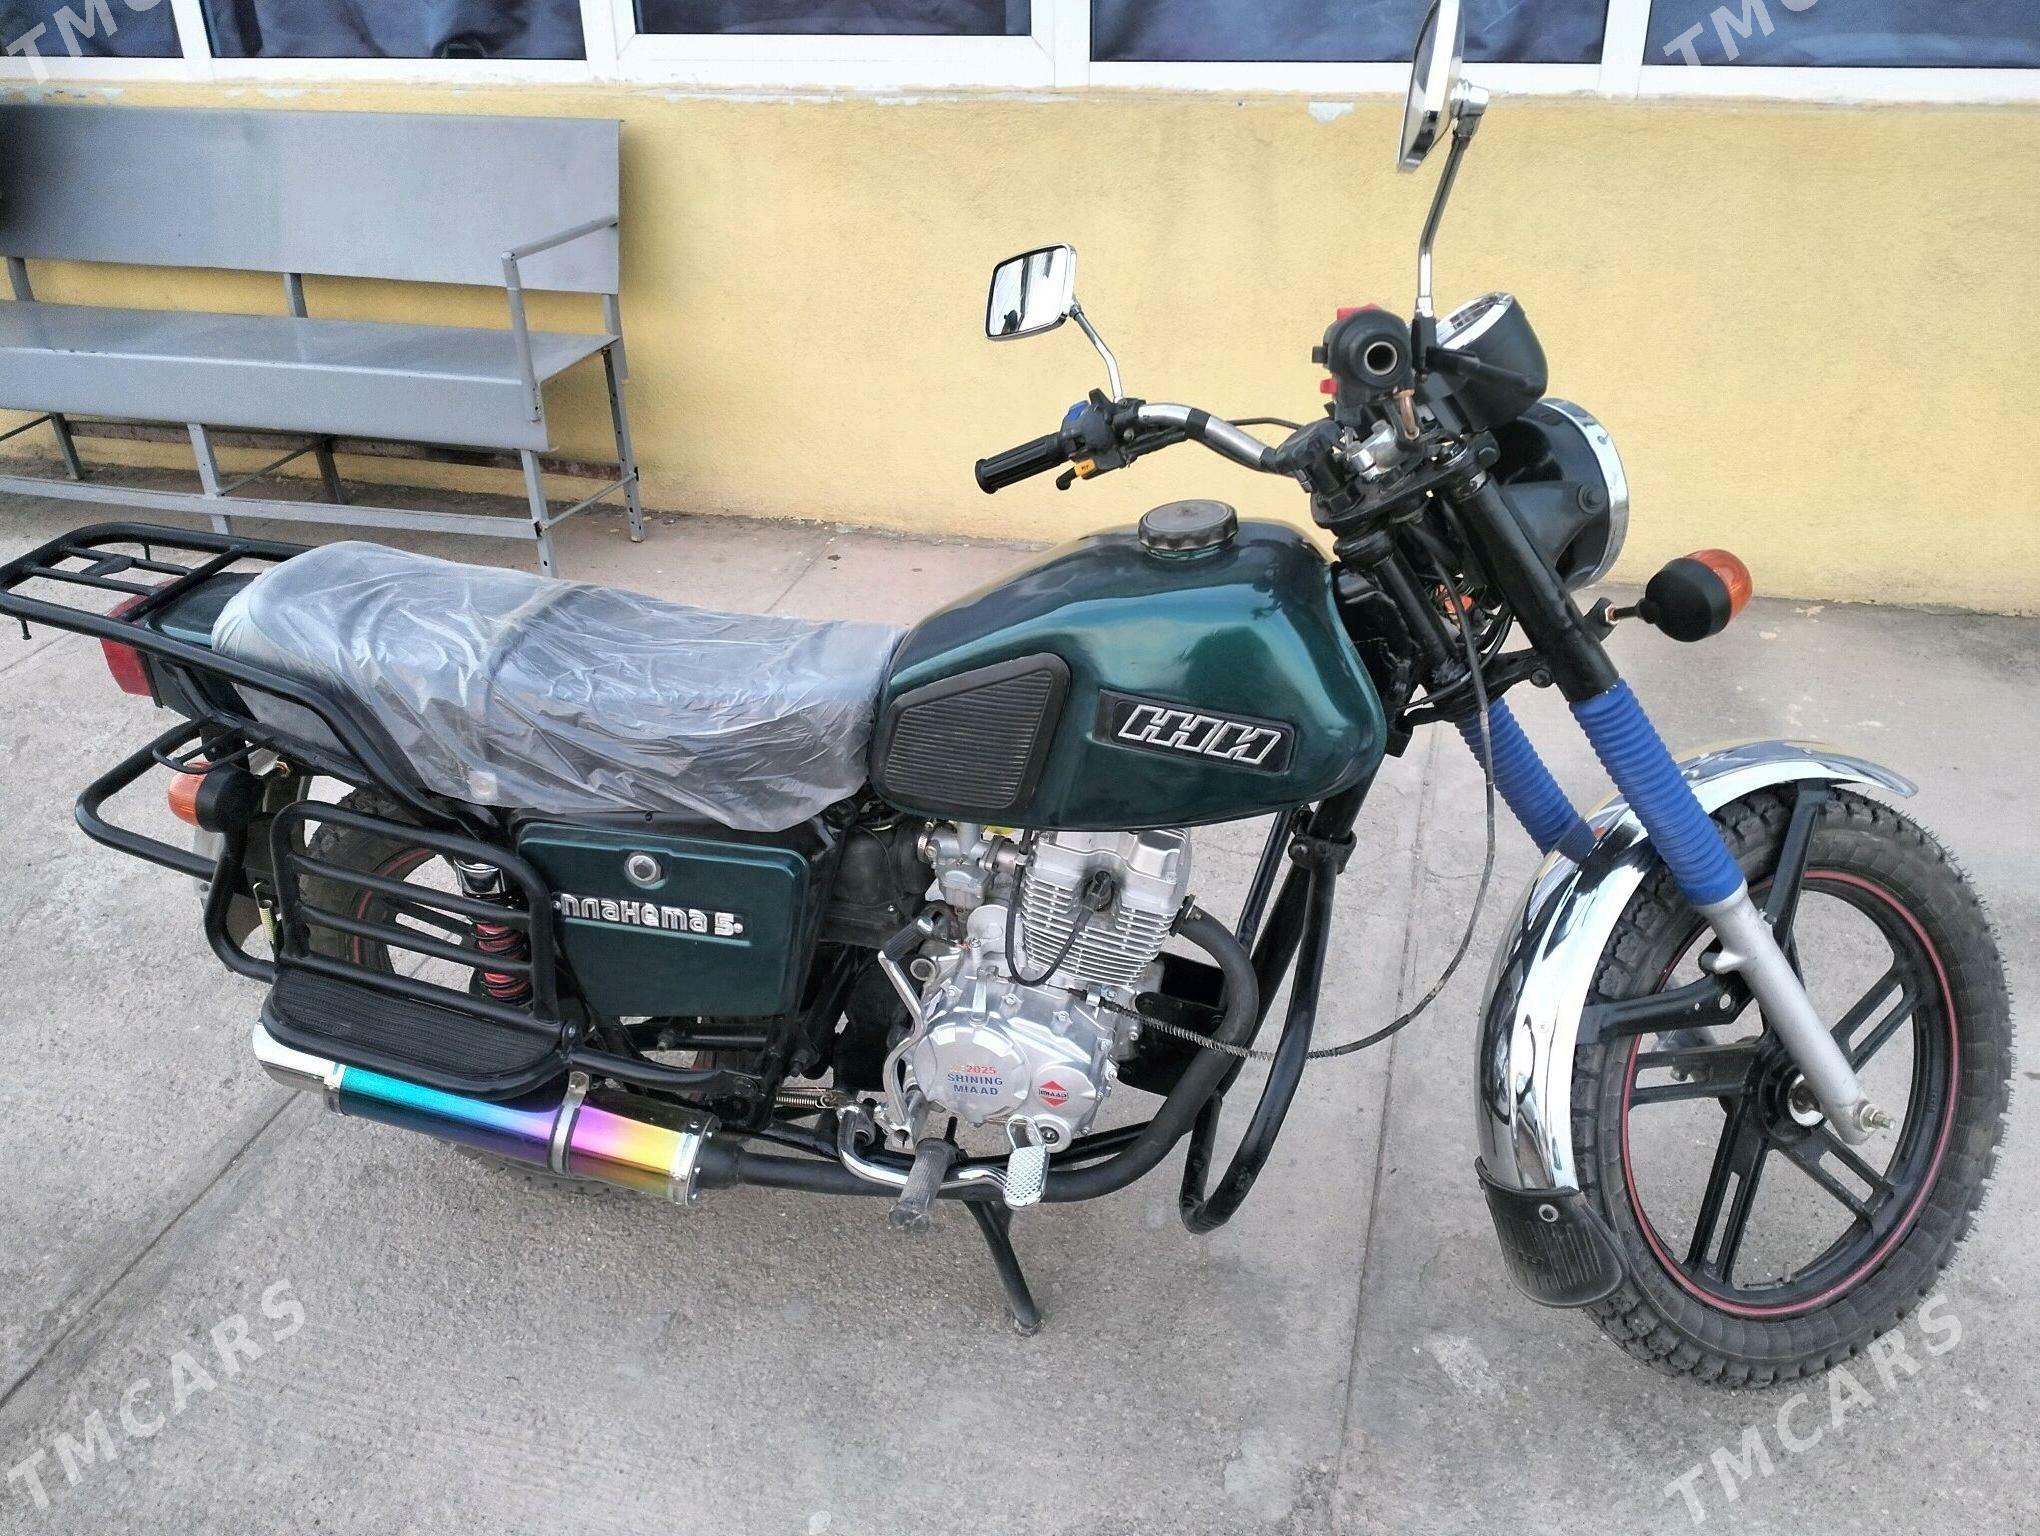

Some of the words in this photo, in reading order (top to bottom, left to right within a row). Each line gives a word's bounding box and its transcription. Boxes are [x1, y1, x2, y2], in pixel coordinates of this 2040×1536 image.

[966, 1064, 997, 1075] 2025
[947, 1072, 1003, 1086] SHINING
[953, 1084, 999, 1096] MIAAD
